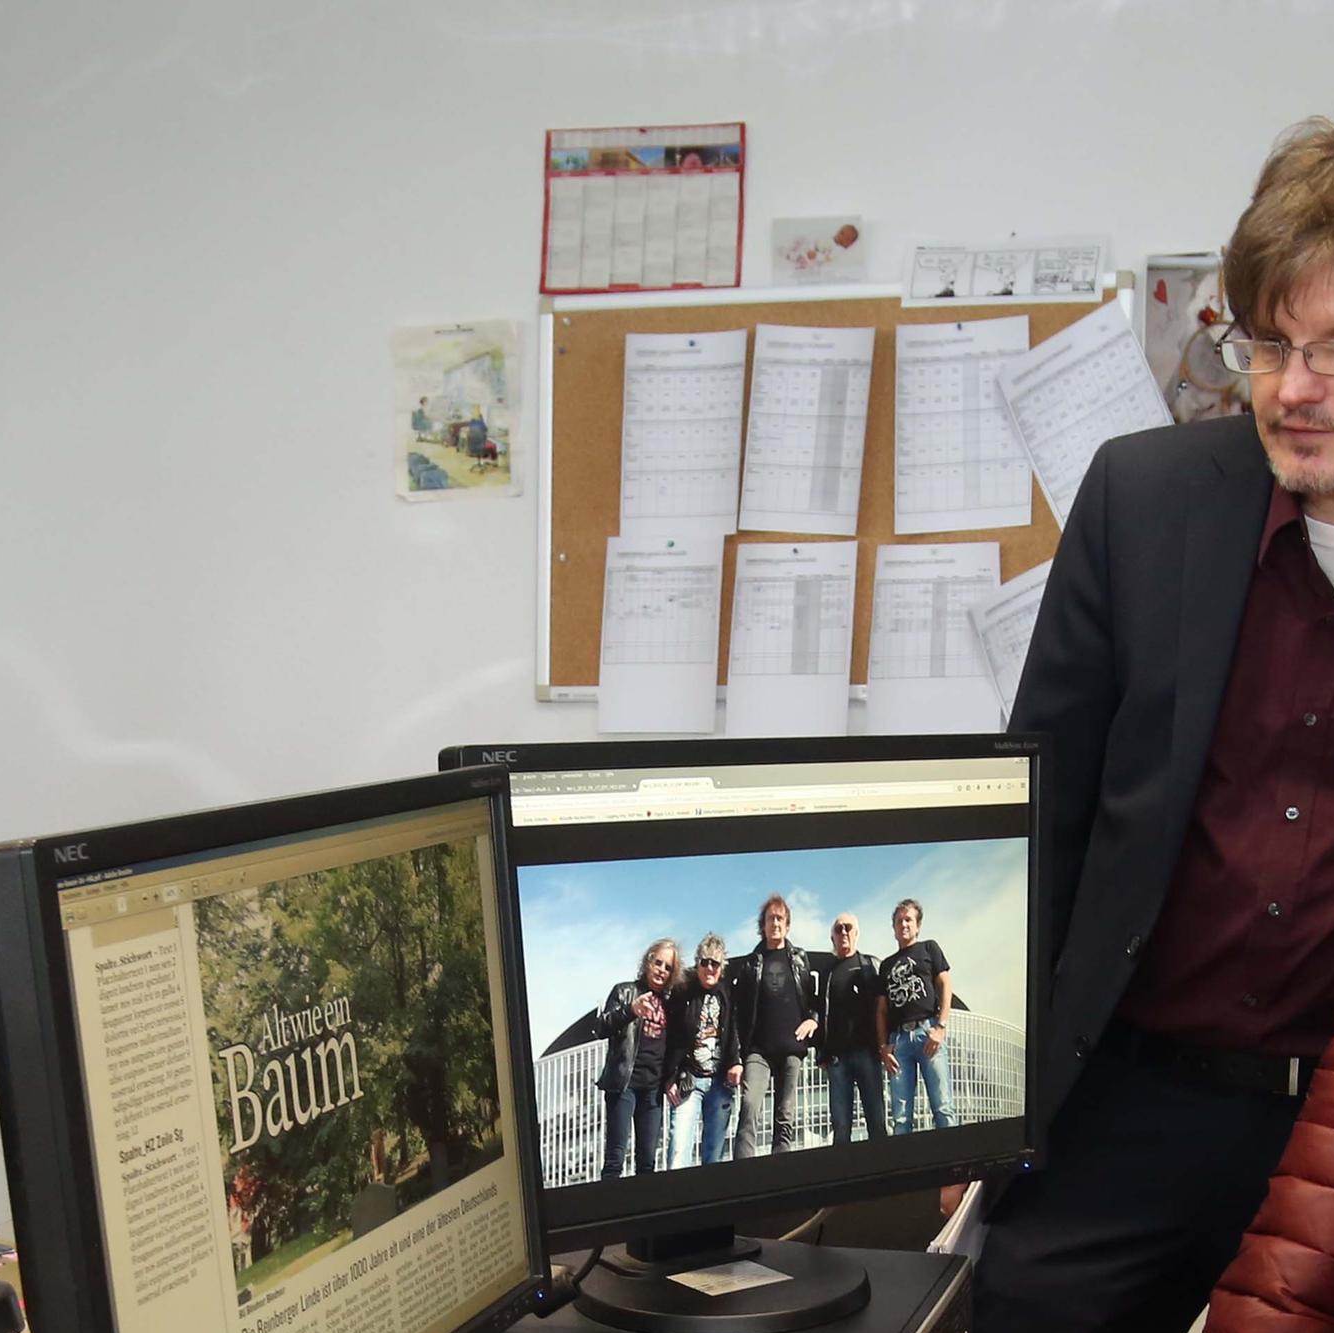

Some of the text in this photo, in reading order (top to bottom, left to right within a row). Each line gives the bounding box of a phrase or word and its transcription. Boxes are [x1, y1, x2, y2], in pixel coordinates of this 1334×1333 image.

[482, 751, 517, 763] NEC
[54, 843, 89, 863] NEC
[260, 986, 352, 1055] Alt wie ein
[219, 1031, 364, 1154] Baum
[300, 1287, 321, 1312] Linde
[322, 1281, 332, 1299] ist
[333, 1274, 350, 1294] über
[350, 1257, 369, 1283] 1000
[369, 1249, 389, 1271] Jahre
[389, 1243, 399, 1259] alt
[399, 1232, 412, 1253] und
[412, 1226, 426, 1245] eine
[426, 1217, 437, 1237] der
[460, 1181, 498, 1215] Deutschlands
